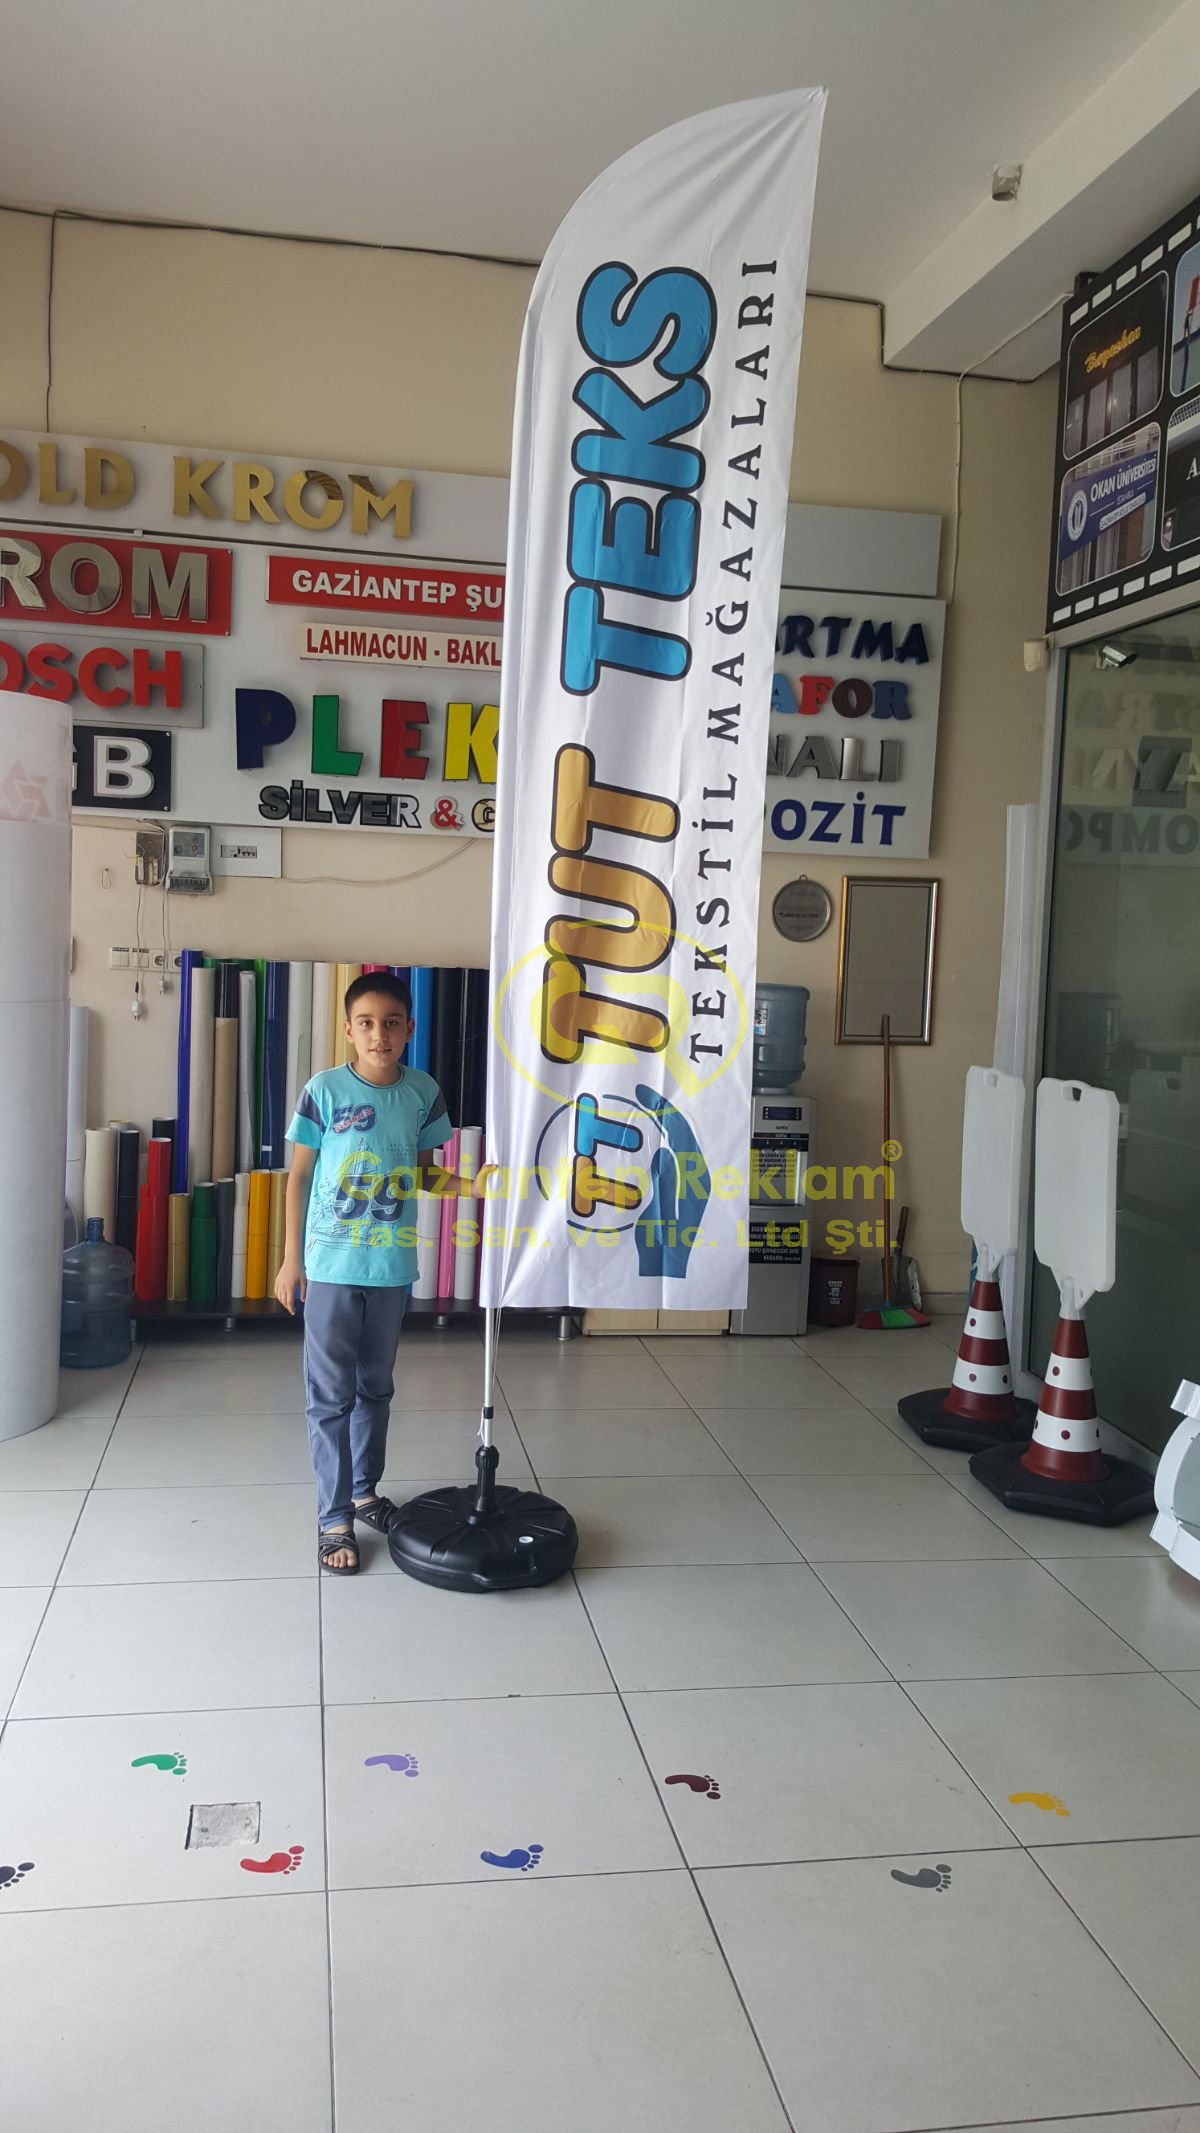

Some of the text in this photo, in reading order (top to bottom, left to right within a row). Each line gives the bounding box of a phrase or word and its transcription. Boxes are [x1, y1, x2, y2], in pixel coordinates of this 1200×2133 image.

[173, 456, 416, 539] KROM
[1090, 476, 1115, 502] OKAN
[292, 569, 502, 612] GAZİANTEP ŞU
[307, 628, 427, 661] LAHMACUN
[447, 639, 502, 667] BAKL
[541, 261, 718, 1064] TUT TEKS
[689, 260, 777, 1063] TEKSTİL MAĞAZALARI
[775, 615, 929, 665] RTMA
[236, 687, 499, 785] PLEK
[73, 736, 155, 799] B
[258, 779, 422, 829] SİLVER
[430, 796, 464, 831] &
[332, 1174, 407, 1222] 59
